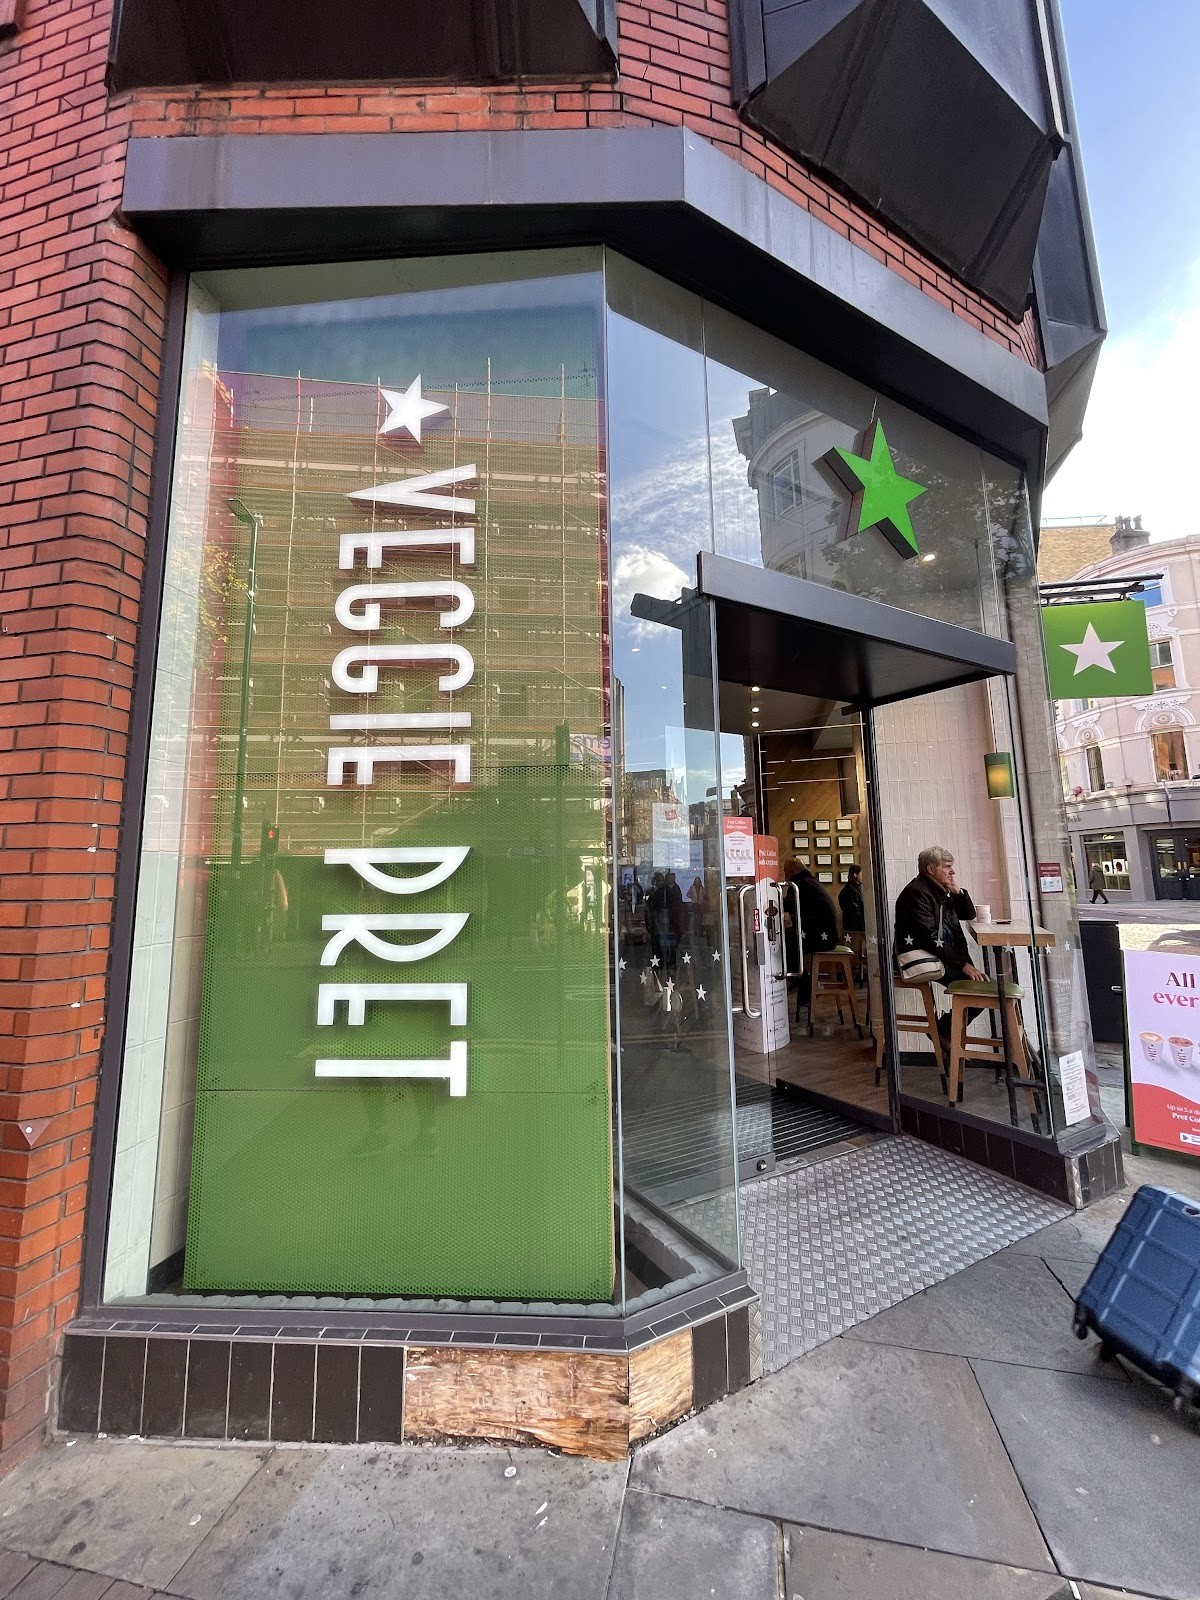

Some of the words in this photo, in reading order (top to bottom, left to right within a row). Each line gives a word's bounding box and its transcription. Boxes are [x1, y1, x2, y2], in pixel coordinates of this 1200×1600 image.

[327, 463, 477, 786] VEGGIE
[314, 846, 471, 1097] PRET
[1166, 971, 1196, 988] All
[1172, 1112, 1188, 1120] Pret
